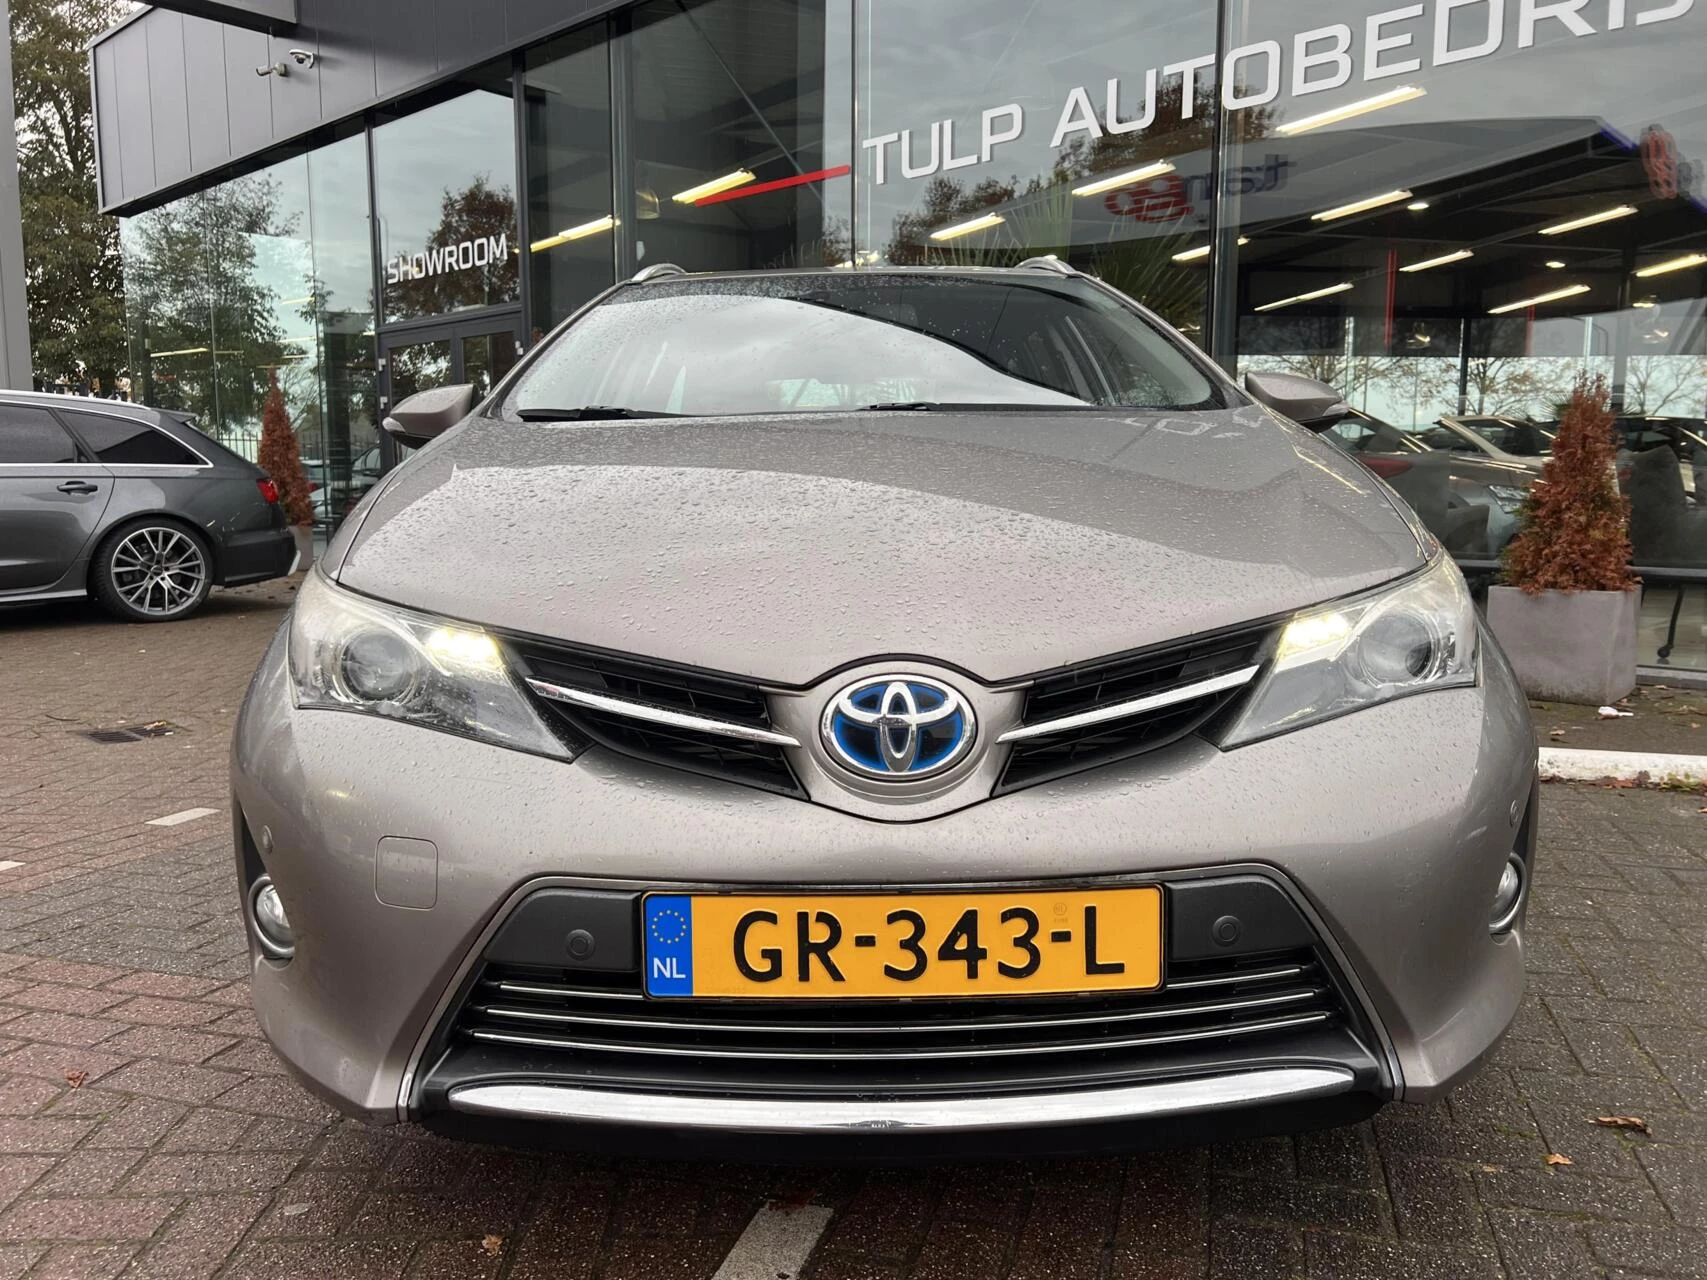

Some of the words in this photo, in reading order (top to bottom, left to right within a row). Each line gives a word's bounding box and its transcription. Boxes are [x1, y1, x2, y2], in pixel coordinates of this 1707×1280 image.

[862, 103, 1023, 185] TULP
[387, 233, 508, 285] SHOWROOM
[653, 957, 686, 979] NL
[732, 905, 1125, 982] GR-343-L
